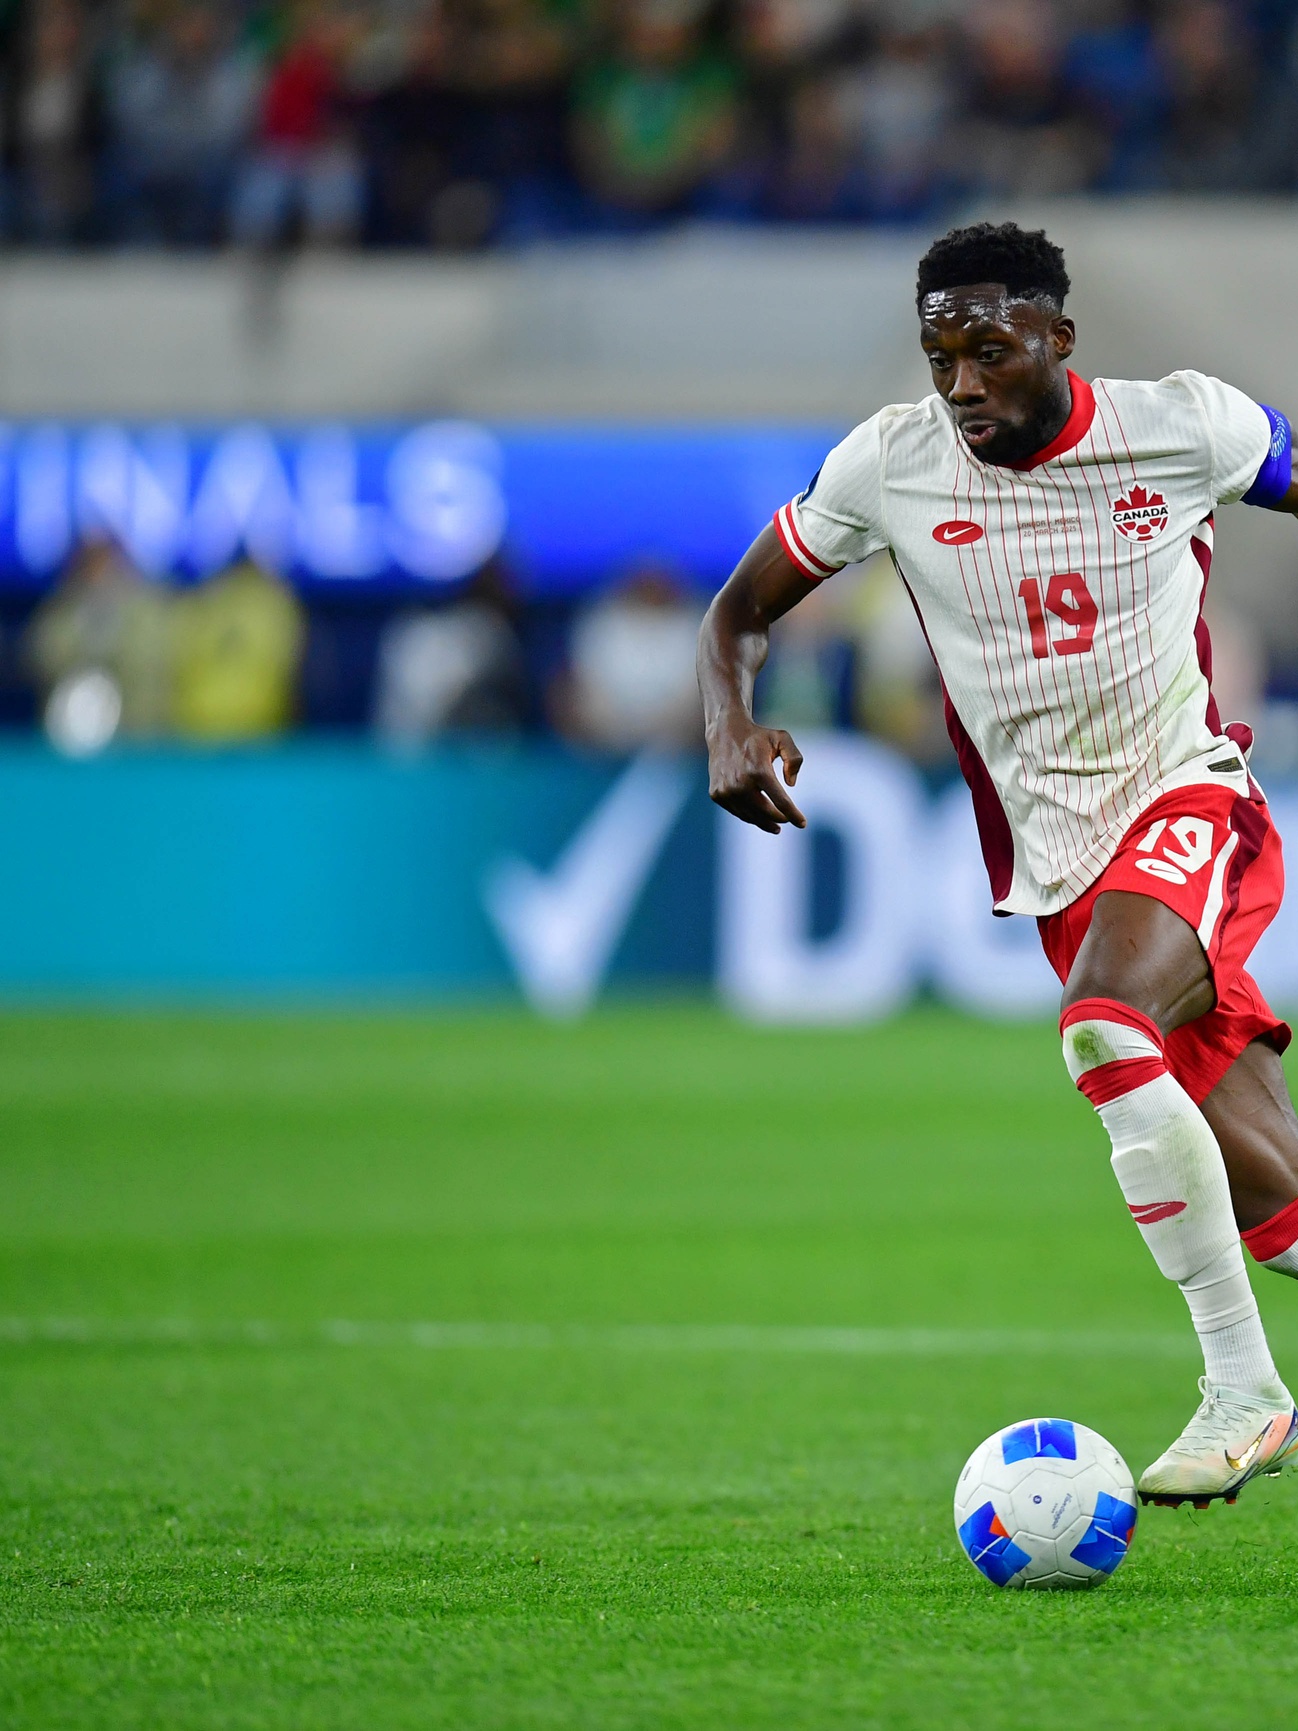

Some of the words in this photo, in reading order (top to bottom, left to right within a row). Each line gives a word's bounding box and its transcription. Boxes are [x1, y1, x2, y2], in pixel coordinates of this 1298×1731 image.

[0, 420, 508, 580] INALS
[1112, 506, 1168, 522] CANADA
[1018, 572, 1099, 659] 19
[1135, 816, 1214, 874] 19
